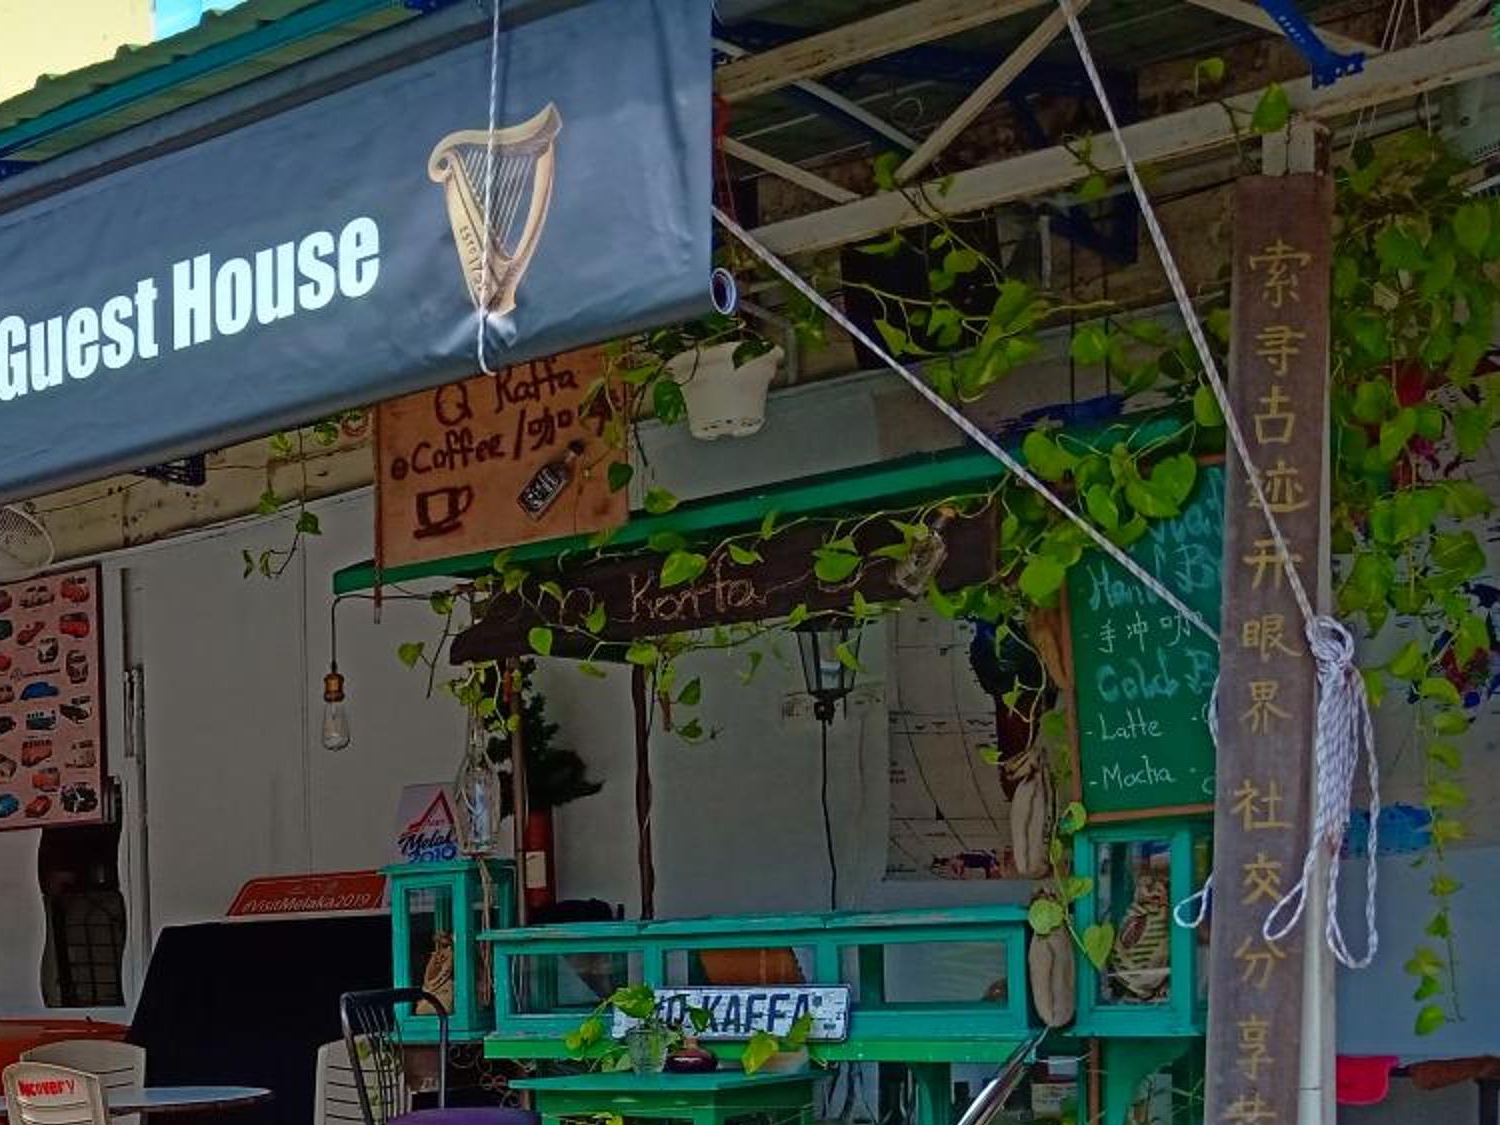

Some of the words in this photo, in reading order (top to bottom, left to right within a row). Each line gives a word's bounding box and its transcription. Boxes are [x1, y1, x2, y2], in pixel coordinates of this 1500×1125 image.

[173, 217, 380, 352] House
[435, 382, 474, 426] Q
[398, 829, 458, 855] Melak
